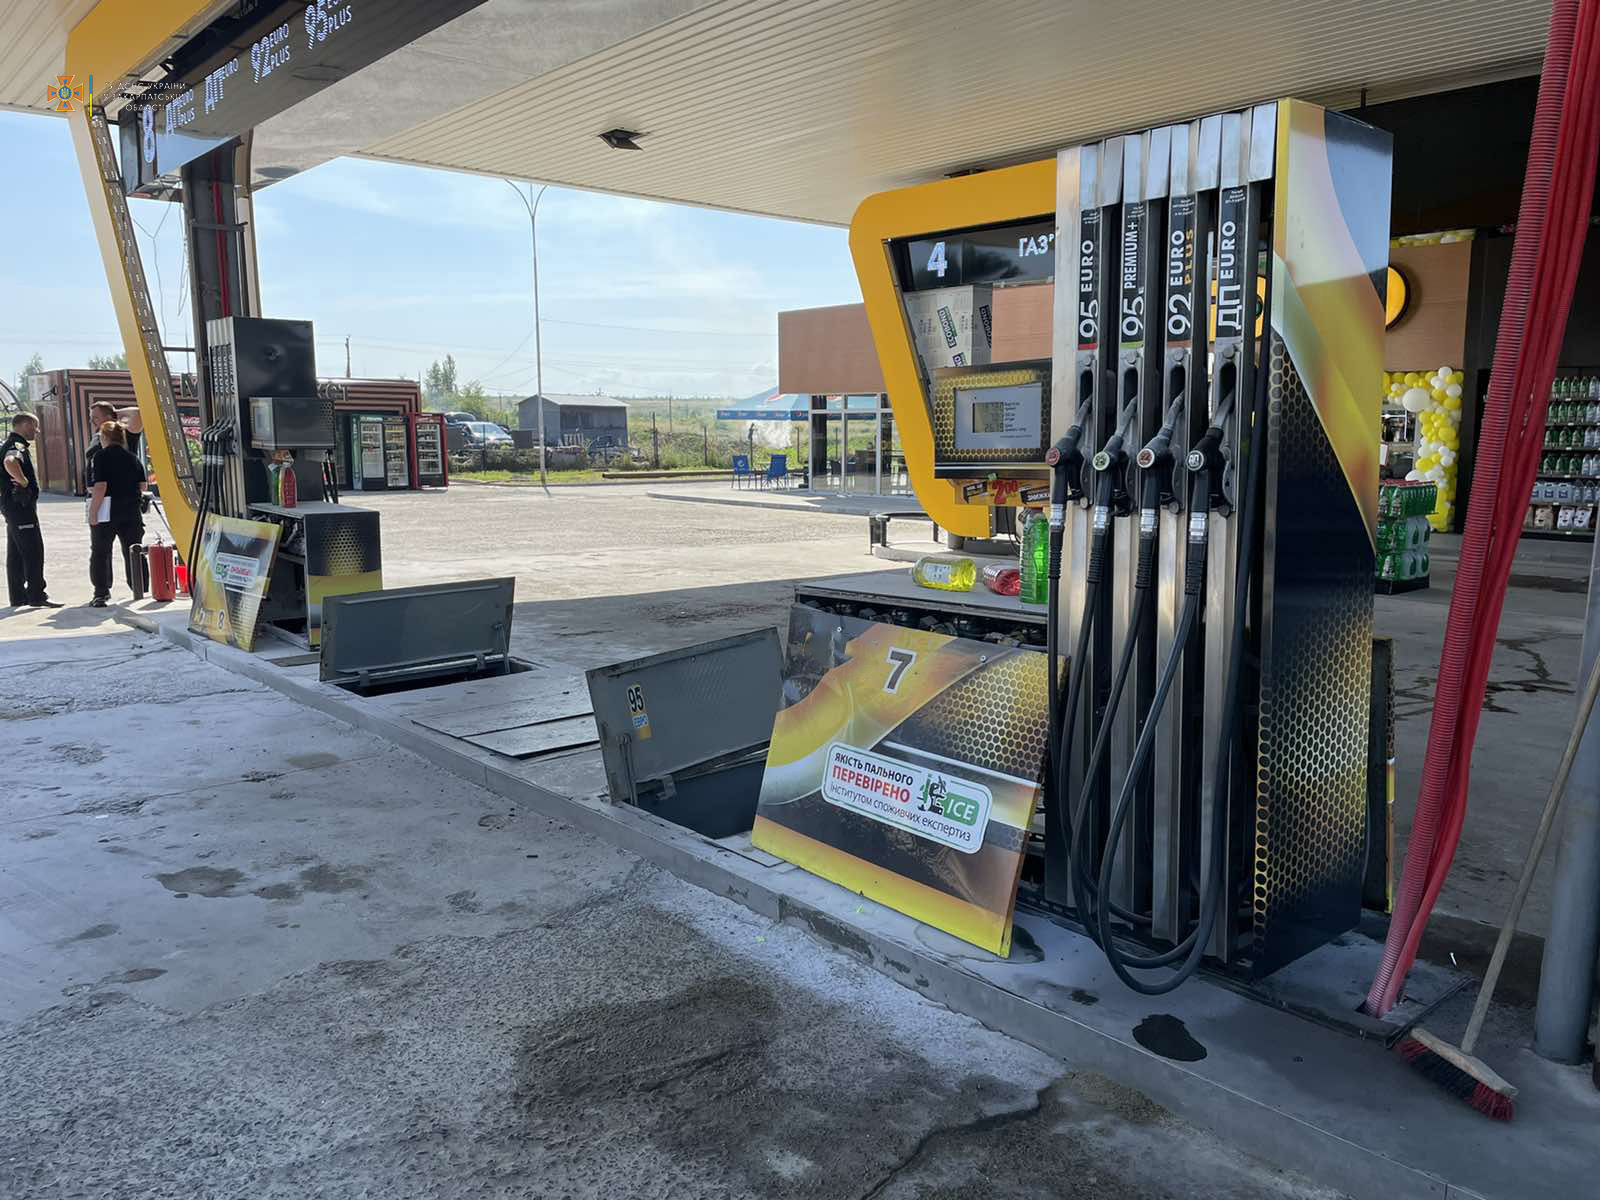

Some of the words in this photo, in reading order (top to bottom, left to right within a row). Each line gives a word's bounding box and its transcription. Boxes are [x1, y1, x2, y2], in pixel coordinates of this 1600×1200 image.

[305, 0, 328, 49] 95
[328, 5, 352, 33] PLUS
[251, 36, 271, 83] 92
[269, 23, 289, 48] EURO
[270, 45, 290, 70] PLUS
[927, 241, 948, 277] 4
[1019, 235, 1049, 256] ГАЗ
[1081, 240, 1094, 292] EURO
[1124, 221, 1138, 289] PREMIUM+
[1170, 230, 1185, 286] EURO
[1184, 229, 1194, 285] PLUS
[1220, 220, 1236, 279] EURO
[1080, 299, 1098, 338] 95
[1122, 295, 1144, 336] 95
[1168, 292, 1192, 335] 92
[1218, 284, 1242, 330] ДП
[883, 648, 916, 693] 7
[627, 686, 643, 712] 95
[832, 764, 911, 803] ПЕРЕВІРЕНО
[834, 752, 864, 770] ЯКІСТЬ
[864, 762, 913, 786] ПАЛЬНОГО
[873, 799, 921, 823] споживчих
[921, 815, 971, 842] експертиз
[946, 798, 975, 821] ICE
